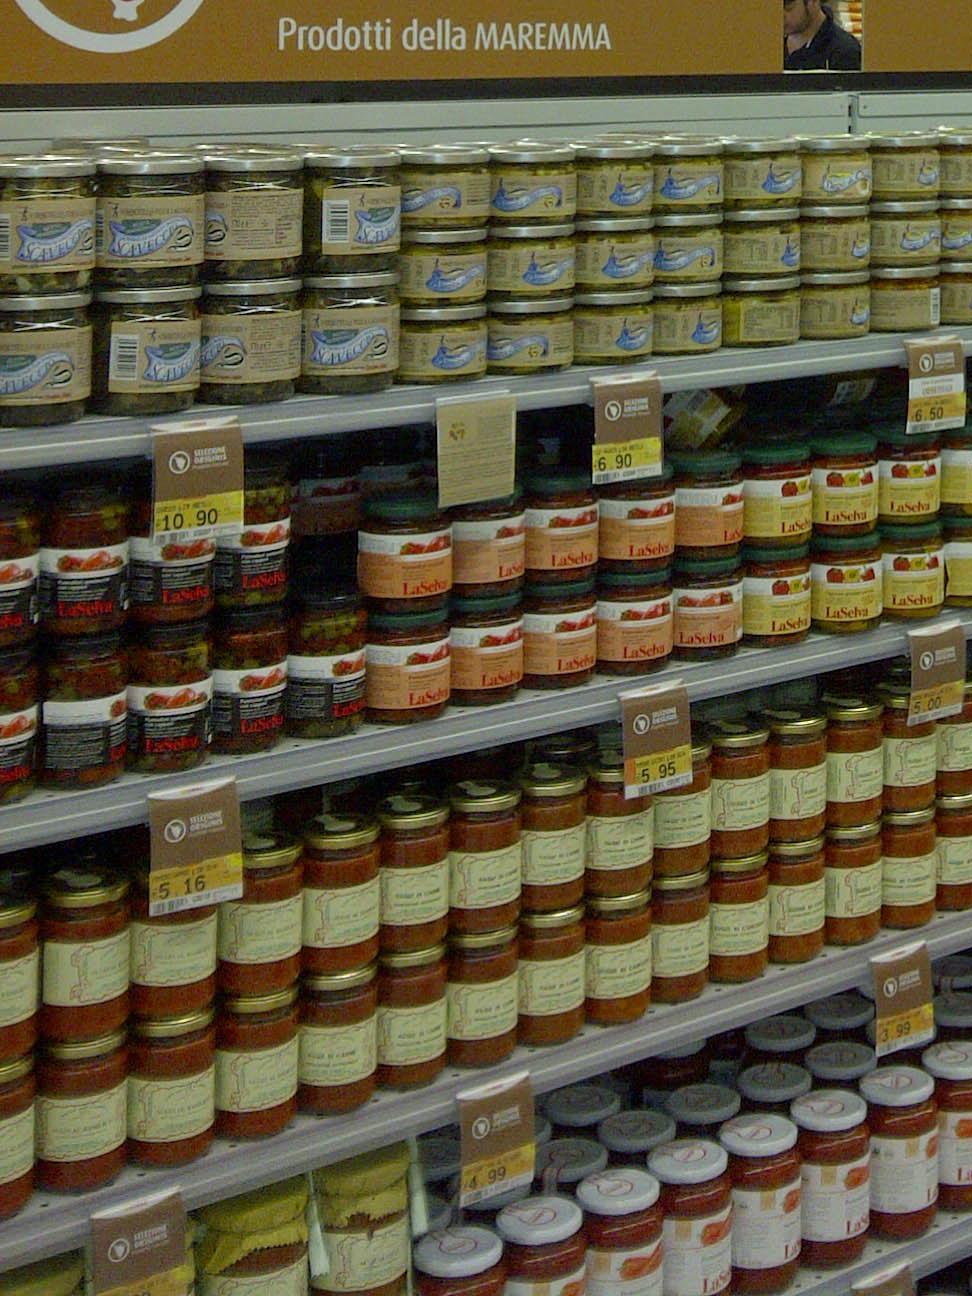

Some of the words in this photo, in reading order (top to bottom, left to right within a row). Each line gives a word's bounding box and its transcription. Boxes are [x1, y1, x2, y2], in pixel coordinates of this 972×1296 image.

[278, 16, 393, 51] Prodotti
[402, 17, 467, 52] della
[474, 22, 611, 51] MAREMMA
[890, 501, 931, 514] LaSelva
[825, 509, 867, 523] LaSelva
[893, 593, 934, 606] LaSelva
[826, 606, 869, 620] LaSelva
[679, 631, 725, 645] LaSelva
